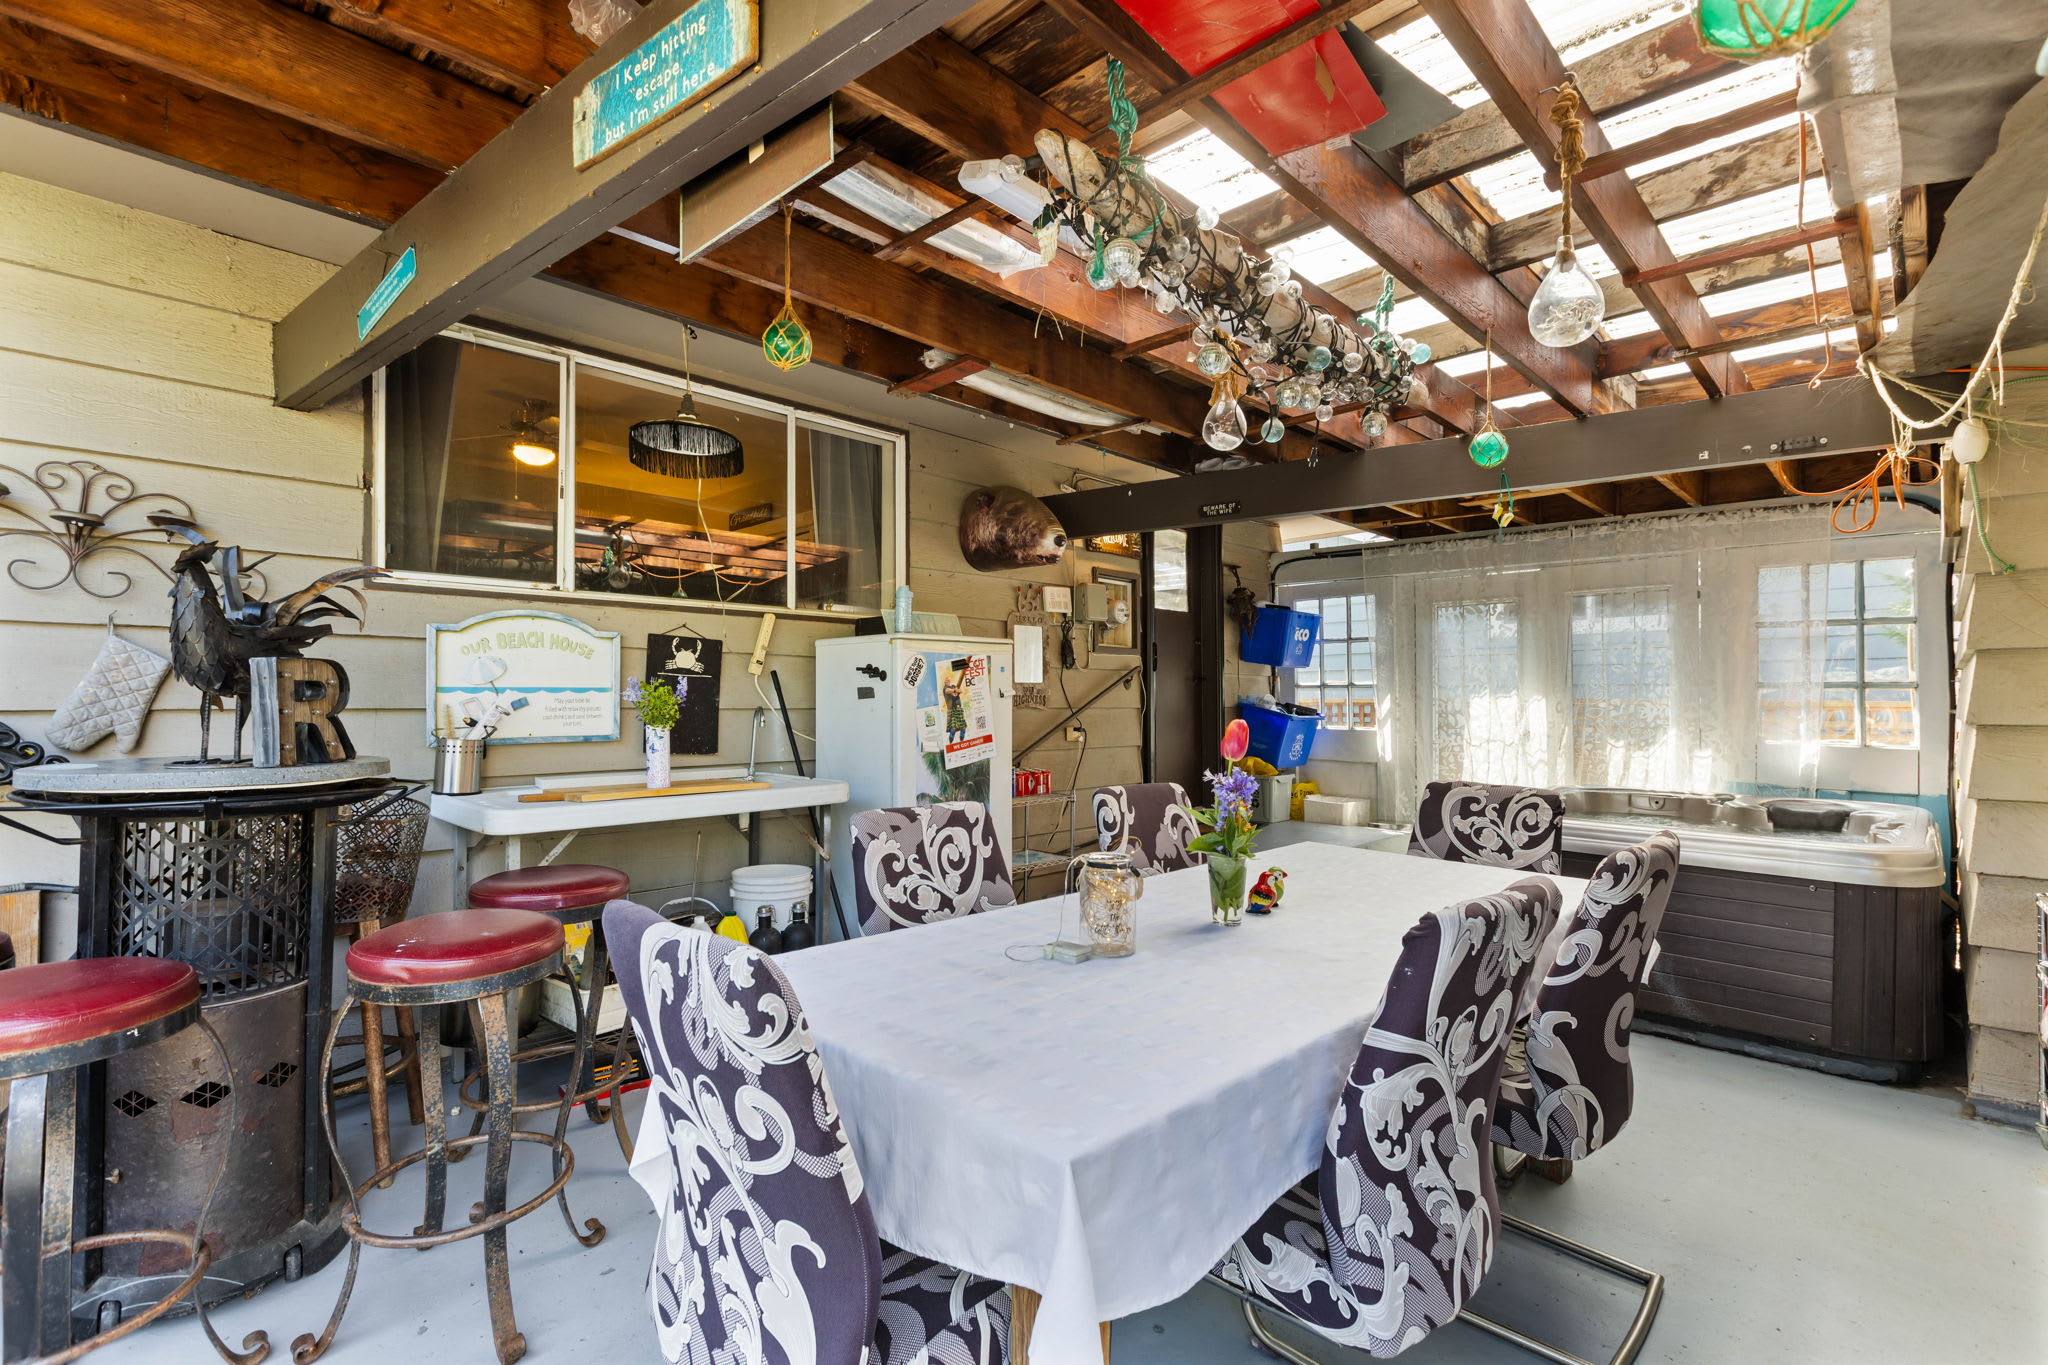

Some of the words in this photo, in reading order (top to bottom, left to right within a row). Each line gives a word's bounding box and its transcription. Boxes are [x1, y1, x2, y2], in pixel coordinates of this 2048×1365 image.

[661, 14, 707, 59] hitting
[605, 122, 626, 146] but
[630, 108, 650, 129] I'm
[653, 83, 678, 114] still
[1015, 614, 1043, 624] HELLO
[461, 637, 493, 657] OUR
[495, 631, 546, 650] BEACH
[548, 632, 596, 660] HOUSE
[908, 657, 925, 688] DOGGIE?
[962, 667, 986, 679] FEST
[965, 677, 976, 687] BC
[1013, 693, 1047, 708] HIGHNESS
